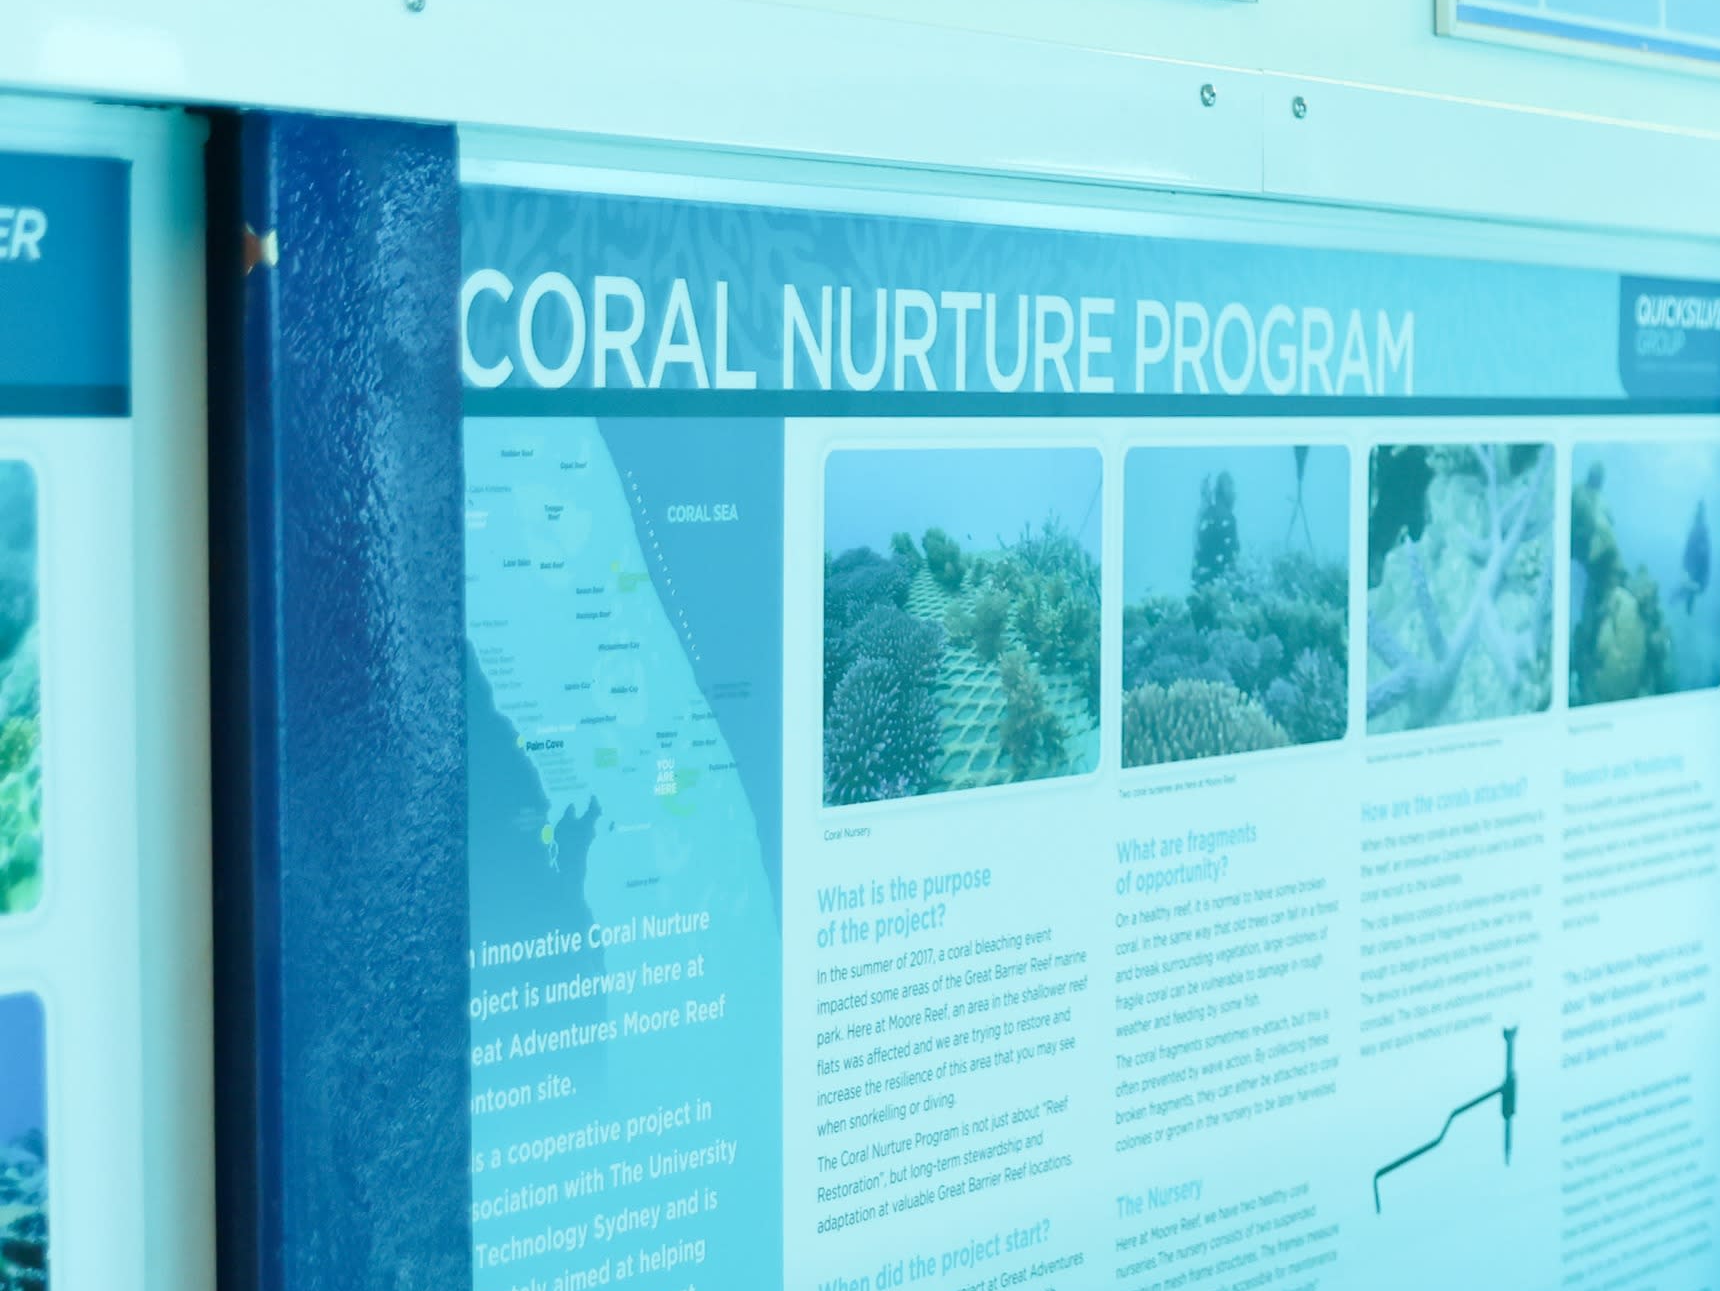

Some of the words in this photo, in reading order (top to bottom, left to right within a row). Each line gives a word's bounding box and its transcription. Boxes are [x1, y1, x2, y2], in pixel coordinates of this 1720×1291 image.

[462, 269, 757, 390] CORAL
[783, 283, 1114, 393] NURTURE
[1135, 298, 1415, 396] PROGRAM
[666, 505, 711, 523] CORAL
[713, 504, 739, 522] SEA
[818, 883, 865, 911] What
[871, 881, 884, 904] is
[890, 876, 917, 901] the
[923, 870, 991, 904] purpose
[482, 932, 581, 965] innovative
[588, 919, 636, 948] Coral
[642, 913, 709, 939] Nurture
[817, 922, 836, 947] of
[840, 918, 869, 943] the
[875, 903, 946, 945] project?
[470, 986, 518, 1019] oject
[524, 984, 539, 1006] is
[545, 972, 636, 1002] underway
[642, 963, 681, 985] here
[687, 954, 704, 977] at
[472, 1038, 502, 1064] eat
[509, 1022, 617, 1057] Adventures
[623, 1010, 679, 1035] Moore
[685, 995, 725, 1023] Reef
[471, 1087, 531, 1112] ntoon
[538, 1076, 575, 1100] site.
[473, 1186, 558, 1220] sociation
[564, 1171, 604, 1199] with
[610, 1164, 643, 1189] The
[649, 1143, 736, 1180] University
[476, 1224, 587, 1266] Technology
[594, 1206, 660, 1239] Sydney
[666, 1190, 699, 1219] and
[704, 1187, 717, 1210] is
[876, 1262, 904, 1290] did
[909, 1256, 936, 1281] the
[942, 1234, 1000, 1279] project
[1006, 1220, 1050, 1252] start?
[616, 1255, 633, 1280] at
[639, 1242, 705, 1273] helping
